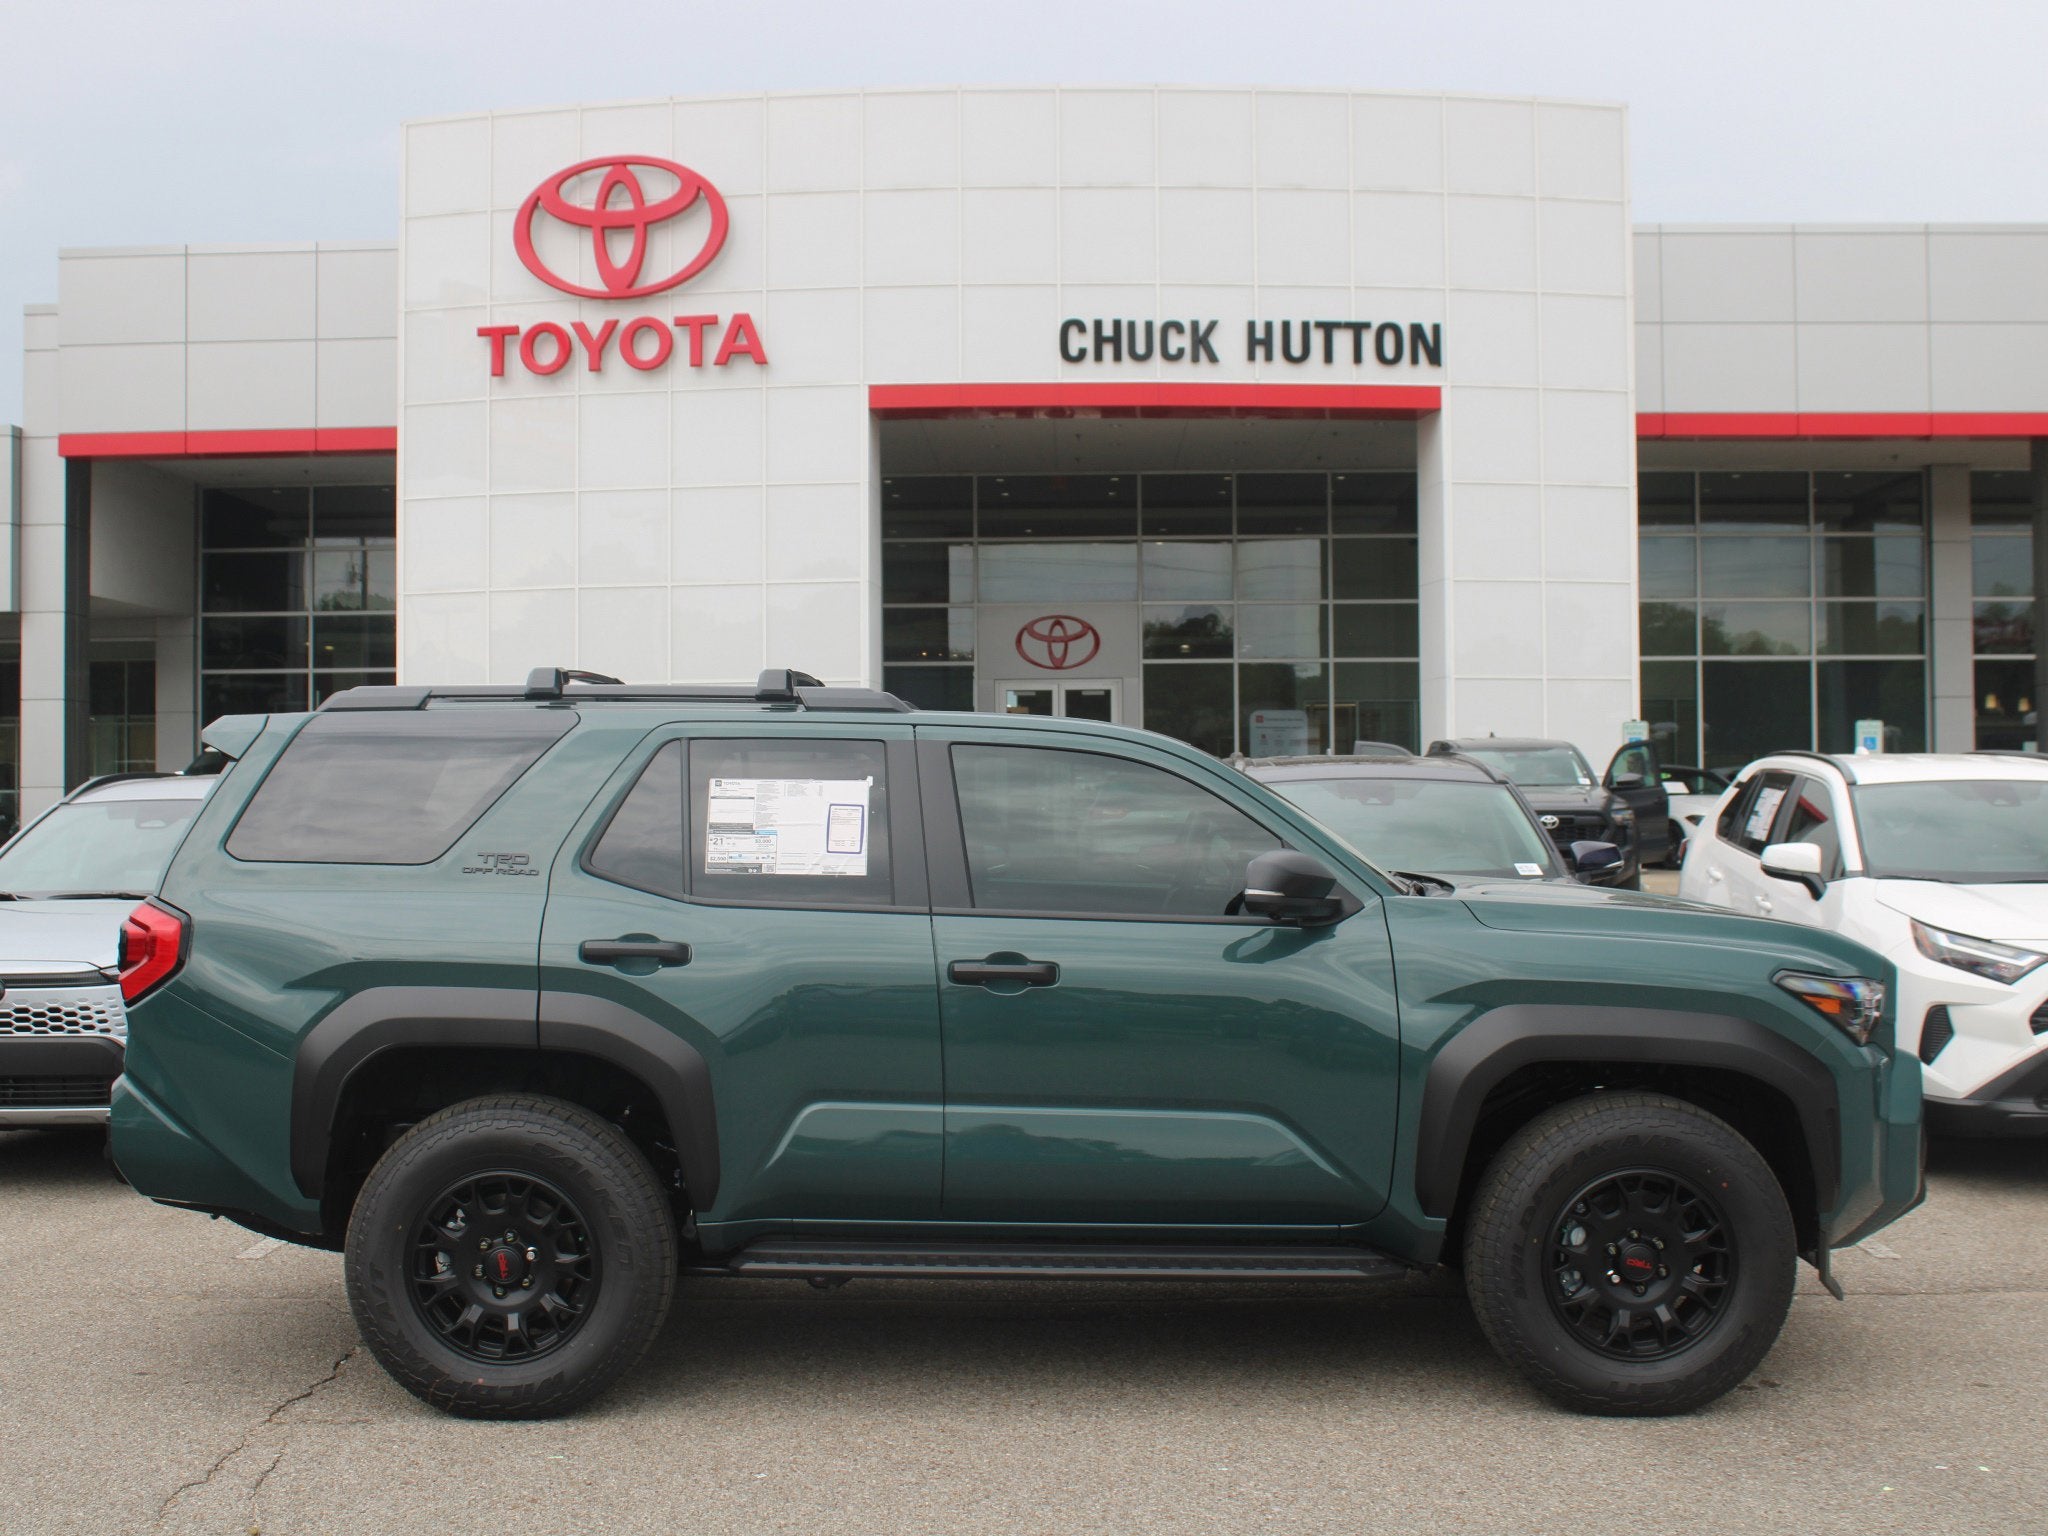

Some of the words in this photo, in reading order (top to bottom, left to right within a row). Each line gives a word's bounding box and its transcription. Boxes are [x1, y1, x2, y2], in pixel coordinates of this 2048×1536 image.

[476, 313, 769, 377] TOYOTA
[1059, 317, 1220, 364] CHUCK
[1246, 319, 1442, 368] HUTTON
[712, 837, 724, 846] 21
[477, 852, 530, 868] TRD
[462, 866, 494, 875] OFF
[496, 868, 540, 876] ROAD
